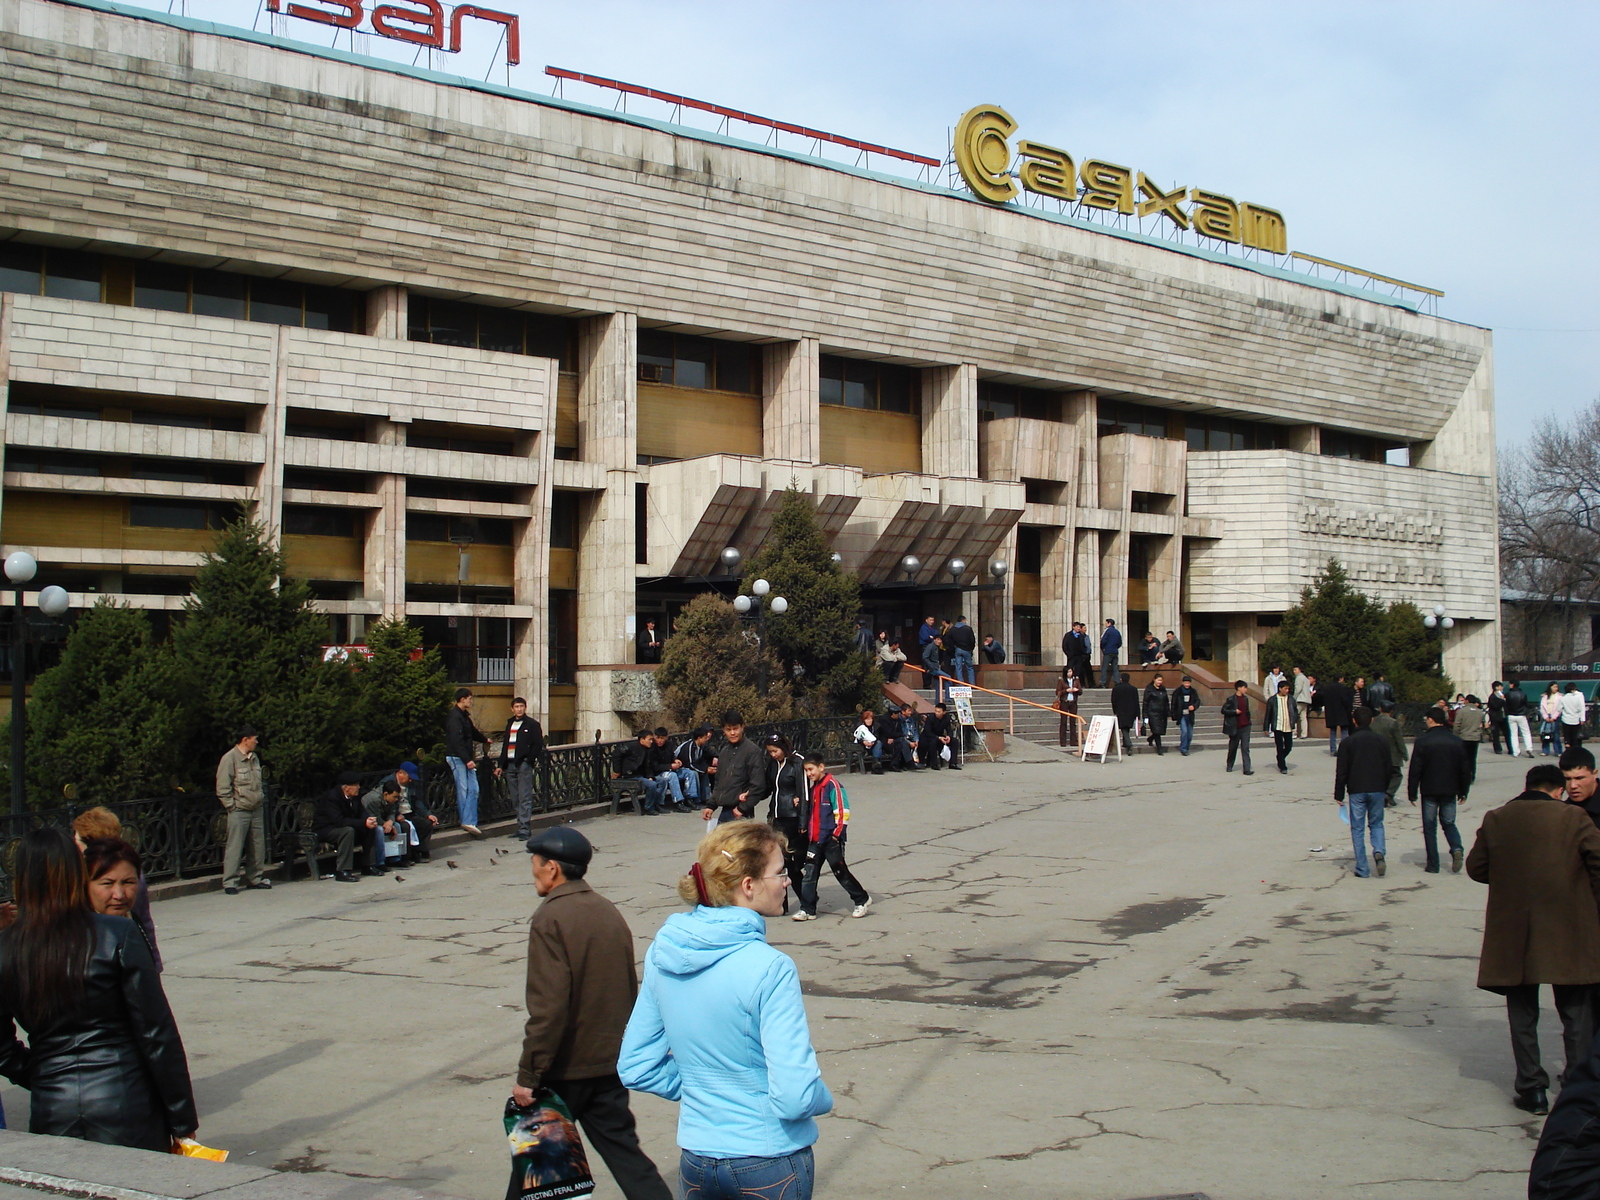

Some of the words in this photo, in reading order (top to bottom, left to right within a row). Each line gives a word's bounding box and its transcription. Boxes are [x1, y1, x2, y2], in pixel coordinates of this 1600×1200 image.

[265, 0, 520, 66] зал
[954, 103, 1287, 255] Саяхат
[1571, 662, 1589, 673] бар
[1090, 721, 1101, 751] ПУНКТ
[553, 1185, 575, 1196] FERAL
[574, 1180, 595, 1191] ANIMA
